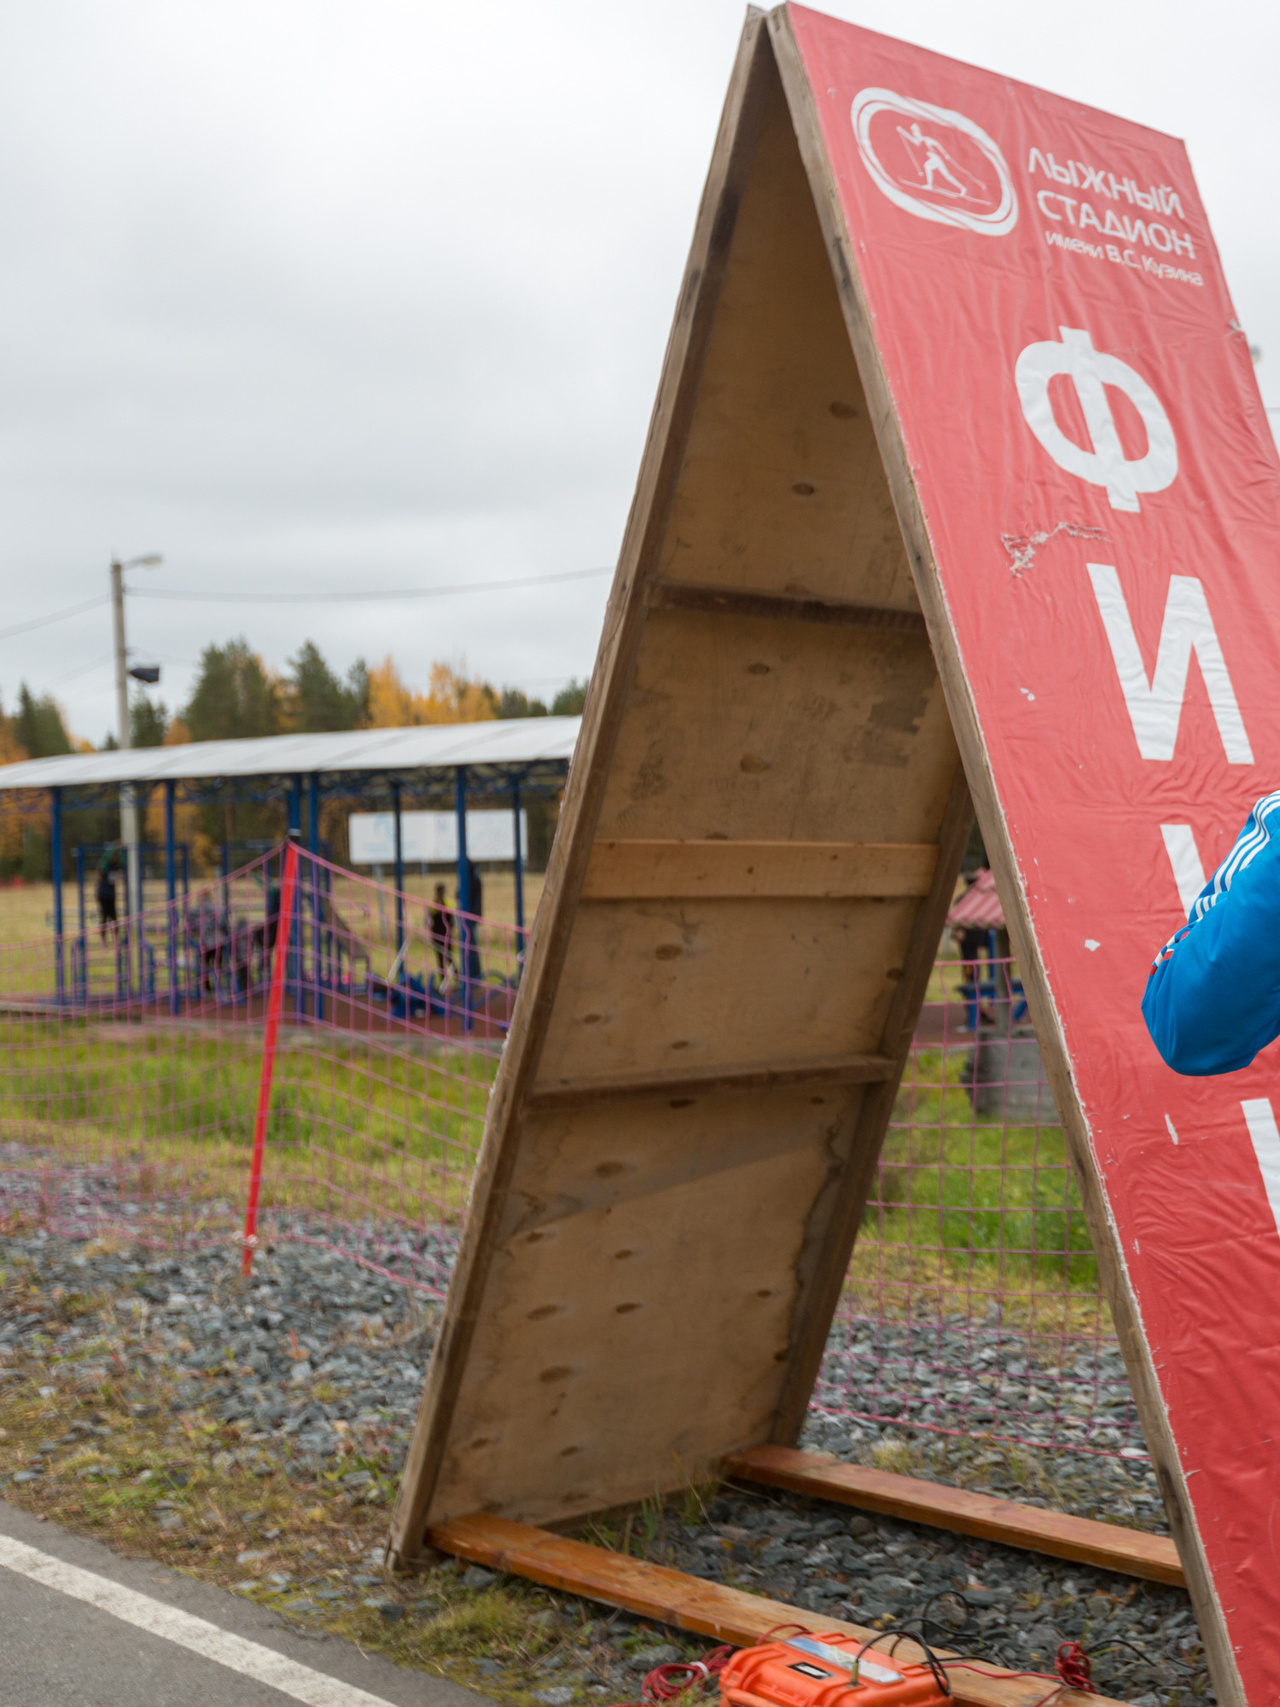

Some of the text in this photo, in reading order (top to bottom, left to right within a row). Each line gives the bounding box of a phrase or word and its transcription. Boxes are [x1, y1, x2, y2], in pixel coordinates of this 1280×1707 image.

[1028, 147, 1185, 219] ЛЫЖНЫЙ
[1037, 190, 1196, 259] СТАДИОН
[1045, 231, 1104, 260] имени
